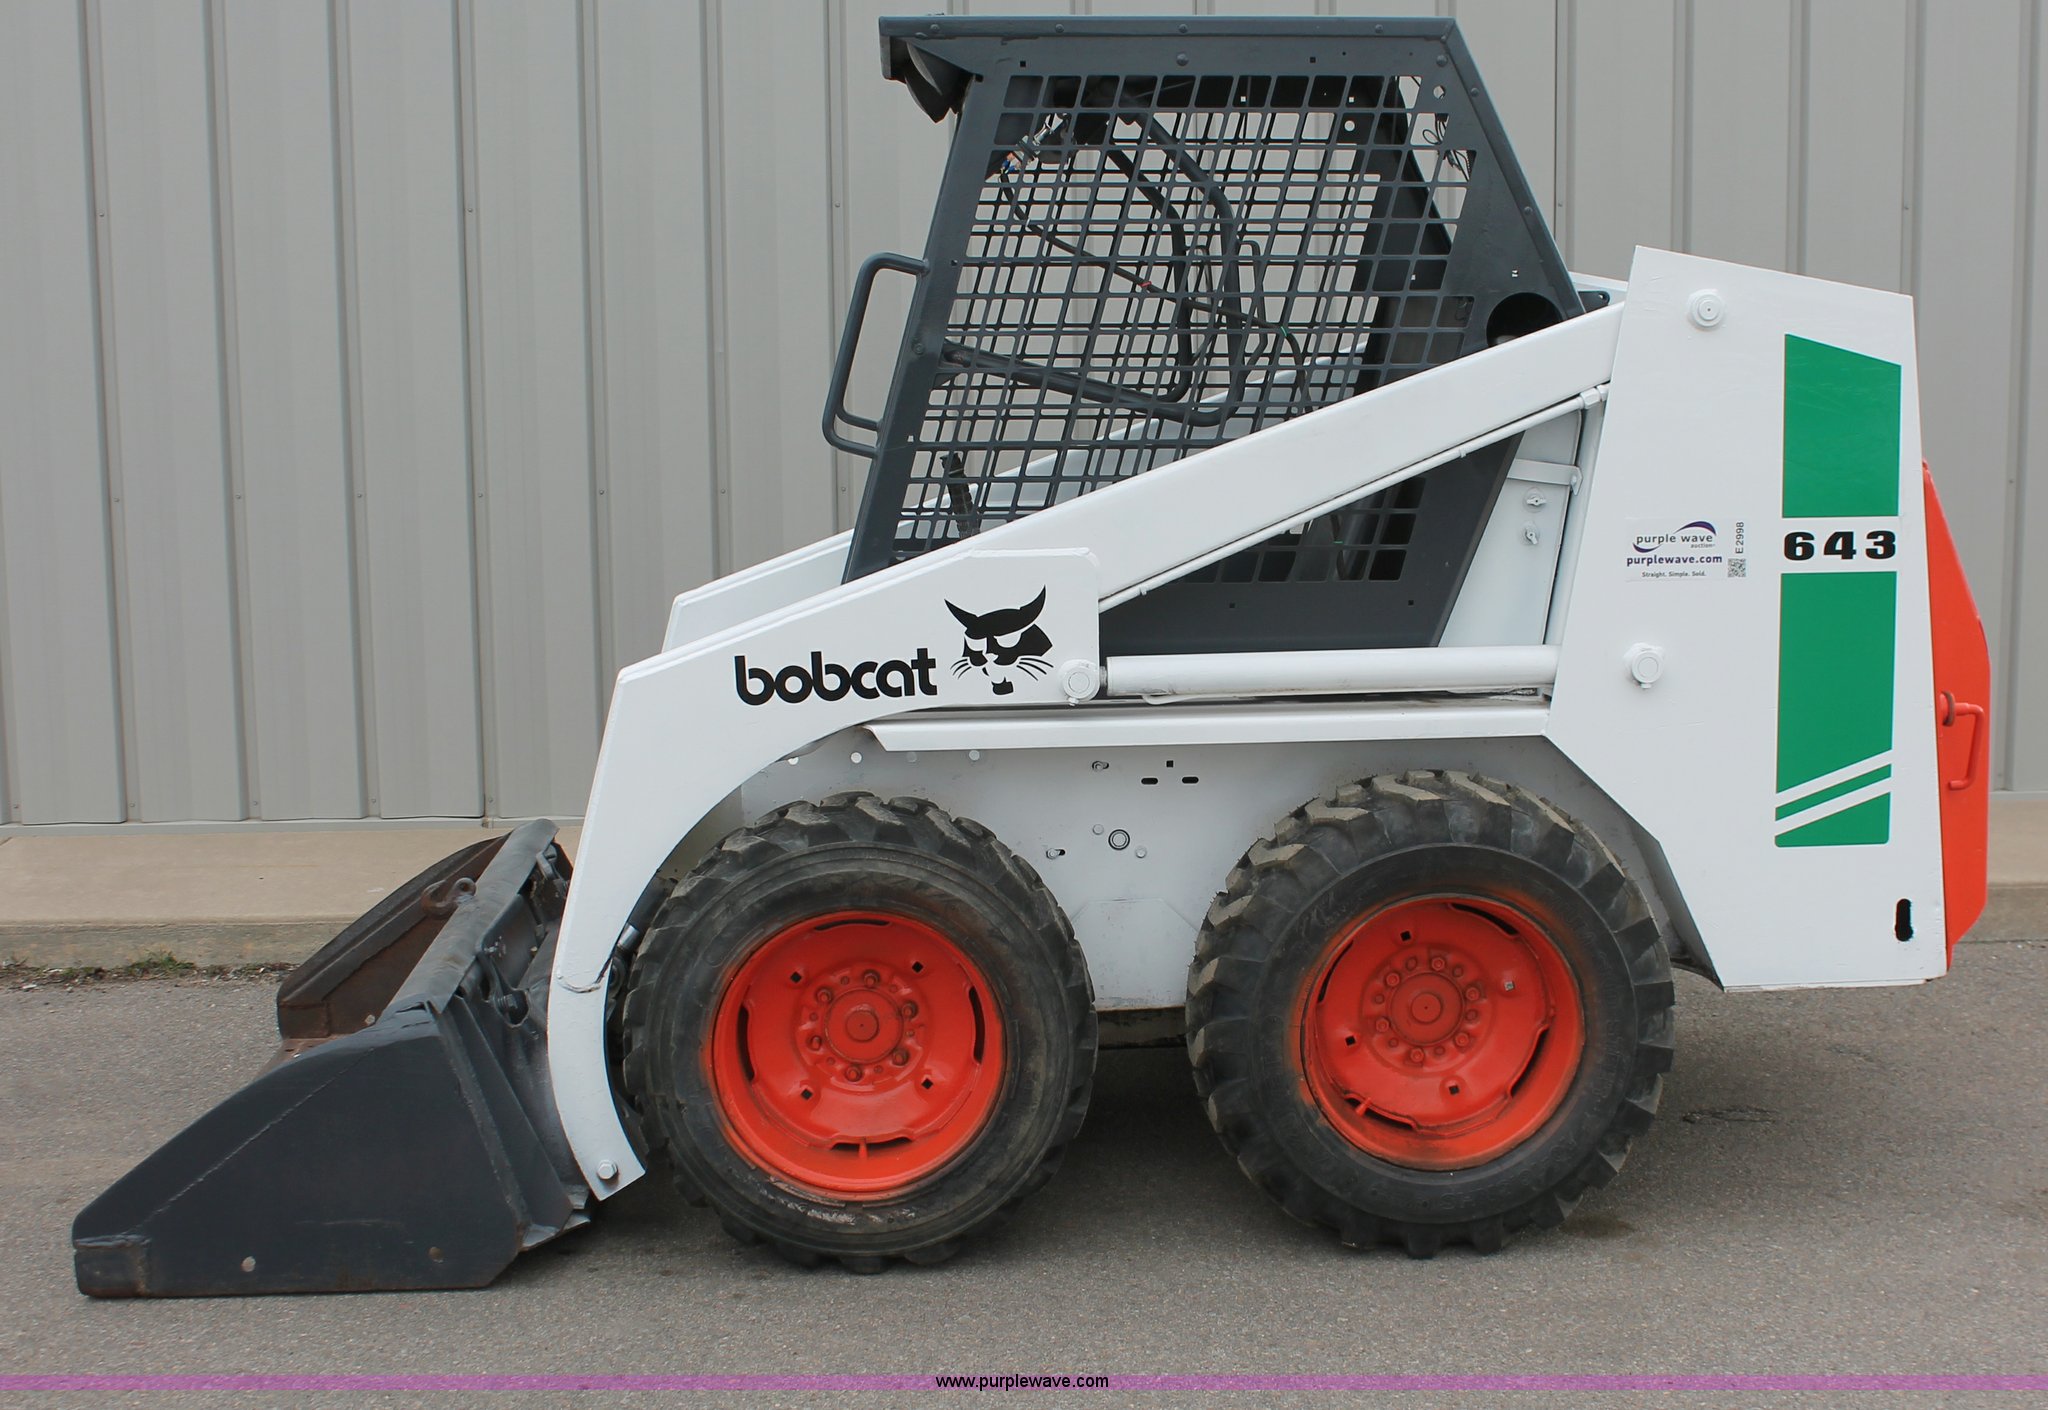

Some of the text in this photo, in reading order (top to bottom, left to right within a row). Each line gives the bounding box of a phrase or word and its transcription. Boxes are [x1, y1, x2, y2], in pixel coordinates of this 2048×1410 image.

[1636, 534, 1713, 545] purple wave
[1784, 530, 1896, 561] 643
[1626, 555, 1722, 567] purplewave.com
[1641, 570, 1706, 579] Straight. Simple. Sold.
[734, 647, 938, 706] bobcat
